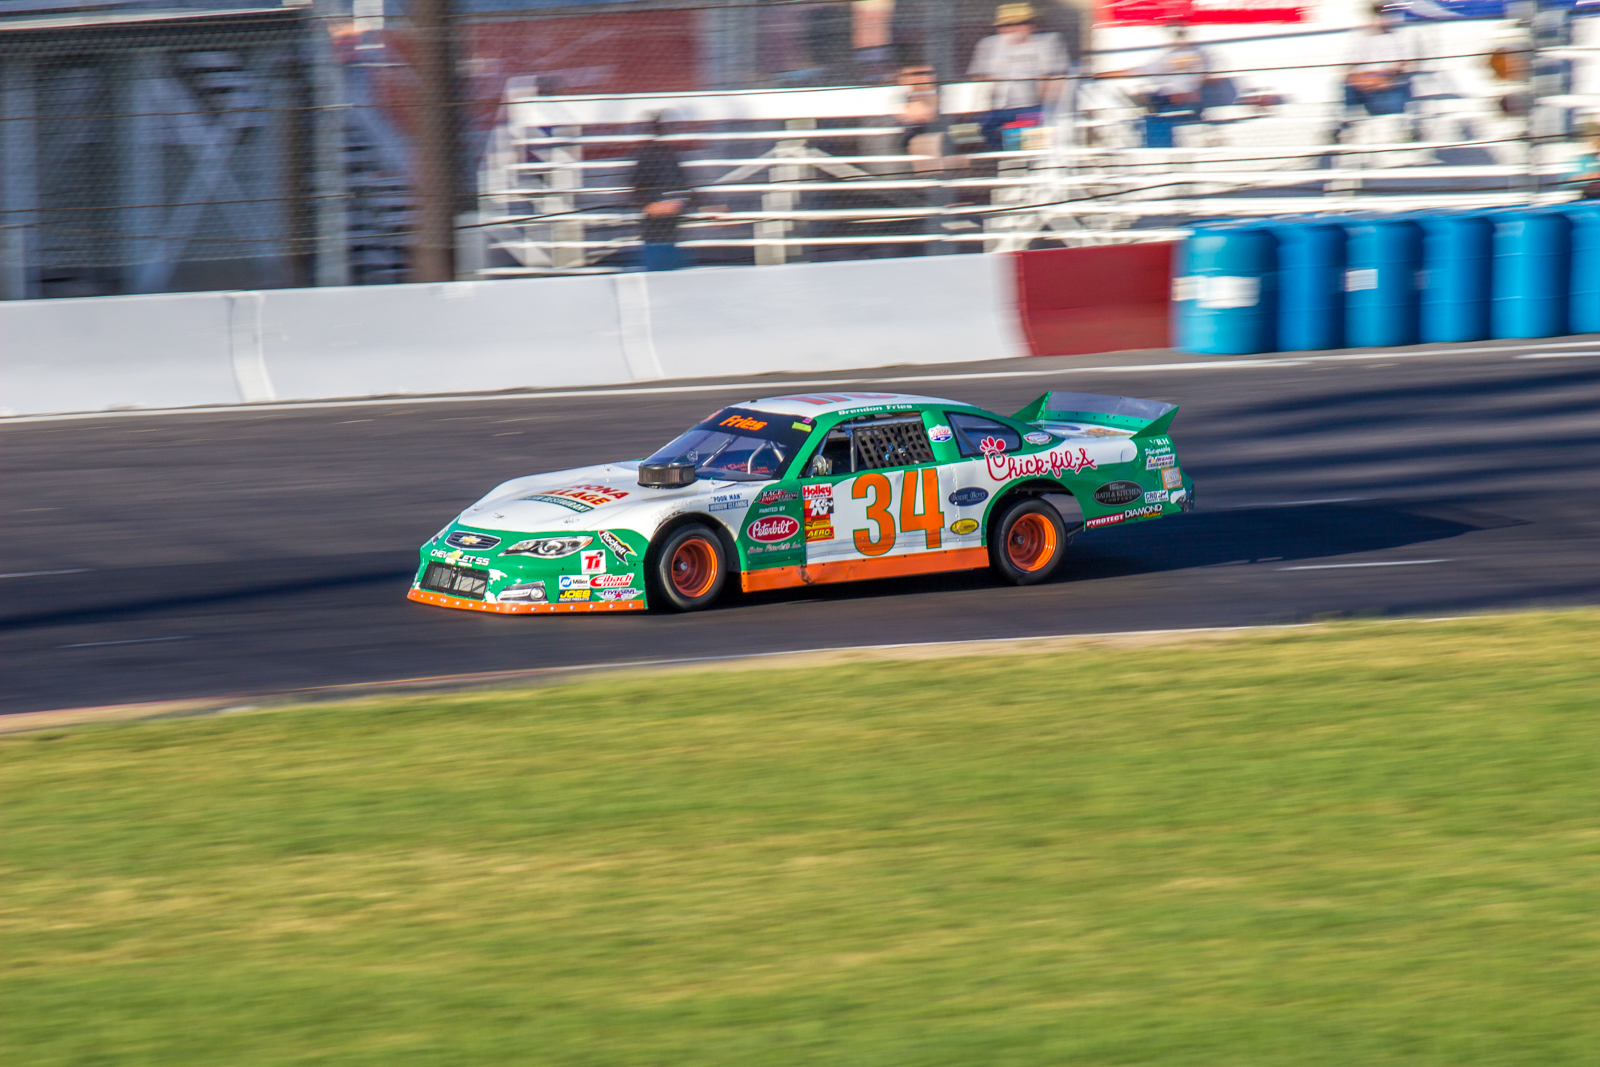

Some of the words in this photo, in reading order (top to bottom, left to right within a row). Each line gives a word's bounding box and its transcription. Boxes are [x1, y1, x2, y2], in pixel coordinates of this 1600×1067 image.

[838, 405, 882, 415] Brendon
[719, 415, 768, 431] Fries
[984, 447, 1097, 481] Chick-fil-A
[762, 489, 782, 497] RACE
[803, 485, 832, 498] Holley
[1095, 491, 1111, 499] BATH
[1116, 487, 1141, 497] KITCHEN
[809, 499, 834, 516] K&N
[851, 468, 945, 557] 34
[1124, 504, 1163, 518] DIAMOND
[1086, 513, 1124, 527] PYROTECT
[752, 520, 794, 538] Peterbilt
[807, 528, 831, 538] AERO
[430, 549, 476, 563] CHEVLET
[475, 556, 490, 566] SS
[590, 573, 633, 587] Eibach
[559, 589, 591, 599] JOES
